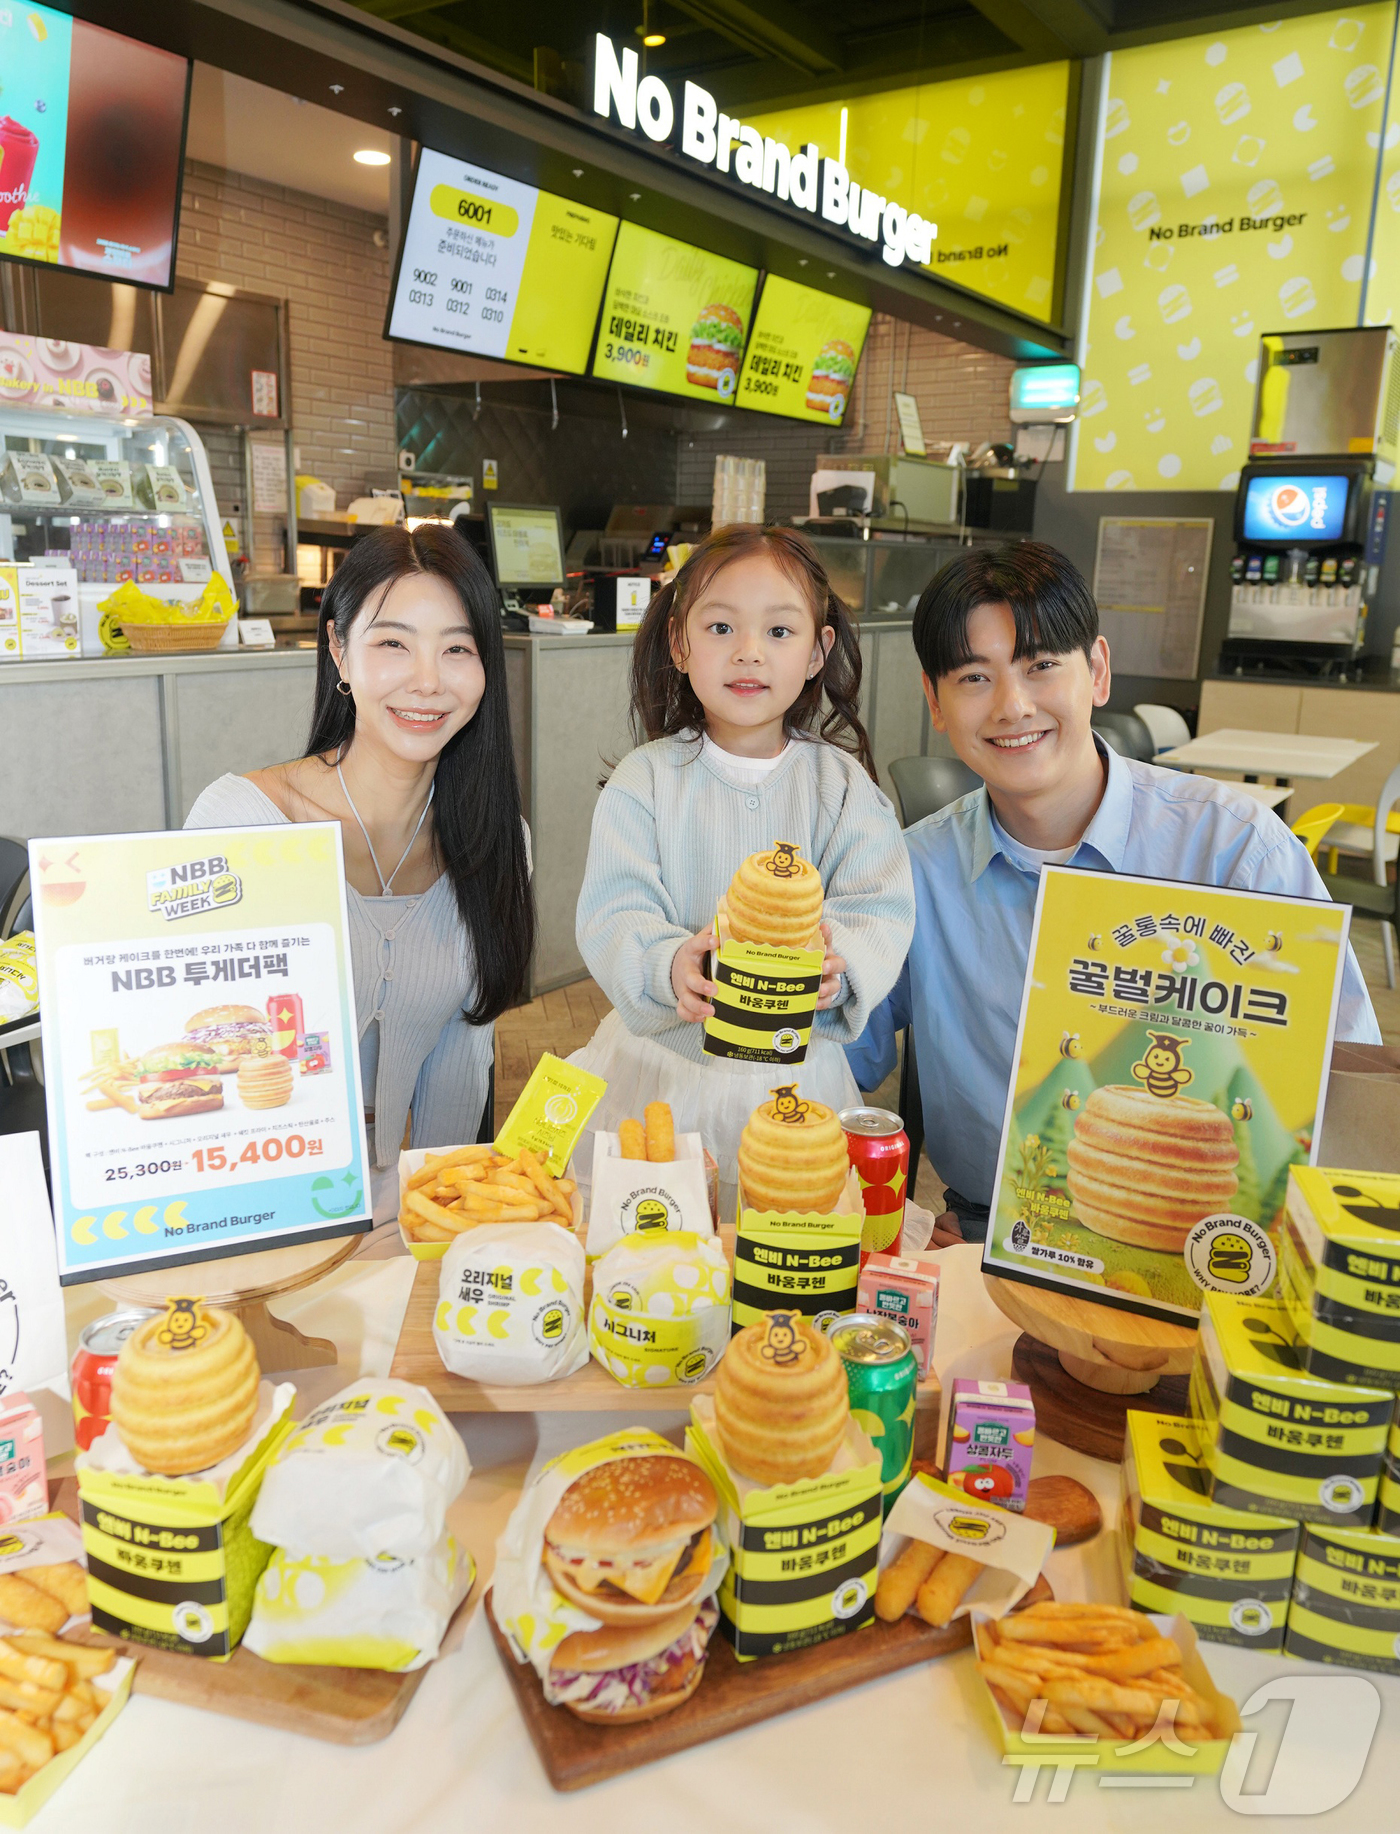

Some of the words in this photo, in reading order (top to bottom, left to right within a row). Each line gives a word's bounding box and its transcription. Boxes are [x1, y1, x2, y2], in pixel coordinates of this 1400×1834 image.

[594, 32, 674, 142] No
[682, 80, 819, 213] Brand
[821, 157, 937, 267] Burger
[458, 199, 492, 225] 6001
[446, 226, 474, 246] 주문하신
[475, 236, 496, 250] 메뉴가
[550, 224, 573, 245] 맛있는
[574, 231, 596, 252] 기다림
[1149, 226, 1174, 241] No
[1177, 218, 1234, 238] Brand
[1238, 212, 1308, 233] Burger
[437, 239, 498, 268] 준비되었습니다
[413, 268, 438, 286] 9002
[450, 278, 472, 294] 9001
[485, 287, 508, 304] 0314
[409, 289, 434, 307] 0313
[446, 298, 470, 316] 0312
[481, 306, 504, 324] 0310
[609, 316, 650, 346] 데일리
[652, 327, 678, 353] 치킨
[604, 343, 650, 368] 3,900원
[750, 354, 781, 378] 데일리
[782, 362, 804, 384] 치킨
[42, 382, 54, 394] in
[58, 378, 99, 399] NBB
[744, 377, 780, 397] 3,900원
[1310, 486, 1328, 530] pepsi
[171, 855, 226, 886] NBB
[151, 878, 212, 906] FAMILY
[164, 896, 212, 918] WEEK
[83, 954, 116, 967] 버거랑
[118, 949, 162, 963] 케이크를
[164, 947, 199, 960] 한번에!
[201, 945, 222, 956] 우리
[224, 942, 244, 954] 가족
[246, 941, 256, 952] 다
[258, 939, 279, 950] 함께
[280, 936, 311, 949] 즐기는
[1112, 913, 1206, 948] 꿀통속에
[1208, 924, 1256, 966] 빠진
[756, 950, 778, 959] Brand
[778, 953, 801, 962] Burger
[111, 966, 176, 993] NBB
[183, 953, 290, 987] 투게더팩
[730, 972, 756, 990] 엔비
[757, 980, 806, 992] N-Bee
[739, 994, 790, 1010] 바움쿠헨
[1068, 958, 1289, 1026] 꿀벌케이크
[1098, 1004, 1138, 1019] 부드러운
[1139, 1010, 1171, 1025] 크림과
[1172, 1016, 1202, 1030] 달콤한
[1204, 1021, 1226, 1034] 꿀이
[1226, 1026, 1248, 1038] 가득
[105, 1160, 182, 1182] 25,300원
[192, 1134, 324, 1173] 15,400원
[880, 1141, 905, 1153] ORIGINAL
[621, 1198, 632, 1212] No
[630, 1186, 658, 1200] Brand
[658, 1188, 681, 1214] Burger
[1016, 1188, 1036, 1200] 엔비
[1036, 1192, 1071, 1208] N-Bee
[1030, 1202, 1070, 1220] 바움쿠헨
[164, 1226, 184, 1238] No
[186, 1218, 228, 1234] Brand
[230, 1210, 276, 1226] Burger
[808, 1222, 834, 1230] Burger
[1192, 1228, 1207, 1244] No
[1204, 1219, 1242, 1232] Brand
[1242, 1222, 1272, 1260] Burger
[753, 1247, 783, 1266] 엔비
[786, 1254, 843, 1268] N-Bee
[1031, 1246, 1056, 1260] 쌀가루
[1058, 1253, 1076, 1264] 10%
[1076, 1257, 1094, 1270] 함유
[1346, 1253, 1388, 1281] 엔비
[462, 1268, 513, 1290] 오리지널
[768, 1273, 826, 1290] 바움쿠헨
[1194, 1268, 1211, 1288] WHY
[458, 1286, 484, 1304] 새우
[488, 1300, 510, 1308] SHRIMP
[532, 1312, 540, 1322] No
[538, 1300, 558, 1314] Brand
[558, 1300, 571, 1317] Burger
[604, 1318, 656, 1344] 시그니처
[1251, 1390, 1290, 1418] 엔비
[1294, 1404, 1370, 1424] N-Bee
[1266, 1424, 1346, 1450] 바움쿠헨
[790, 1486, 818, 1498] Brand
[820, 1480, 850, 1492] Burger
[96, 1512, 132, 1541] 엔비
[134, 1525, 200, 1550] N-Bee
[763, 1529, 799, 1550] 엔비
[802, 1510, 865, 1544] N-Bee
[1160, 1516, 1198, 1542] 엔비
[1200, 1529, 1274, 1551] N-Bee
[116, 1548, 184, 1575] 바움쿠헨
[781, 1542, 847, 1572] 바움쿠헨
[1176, 1548, 1251, 1575] 바움쿠헨
[1325, 1546, 1364, 1572] 엔비
